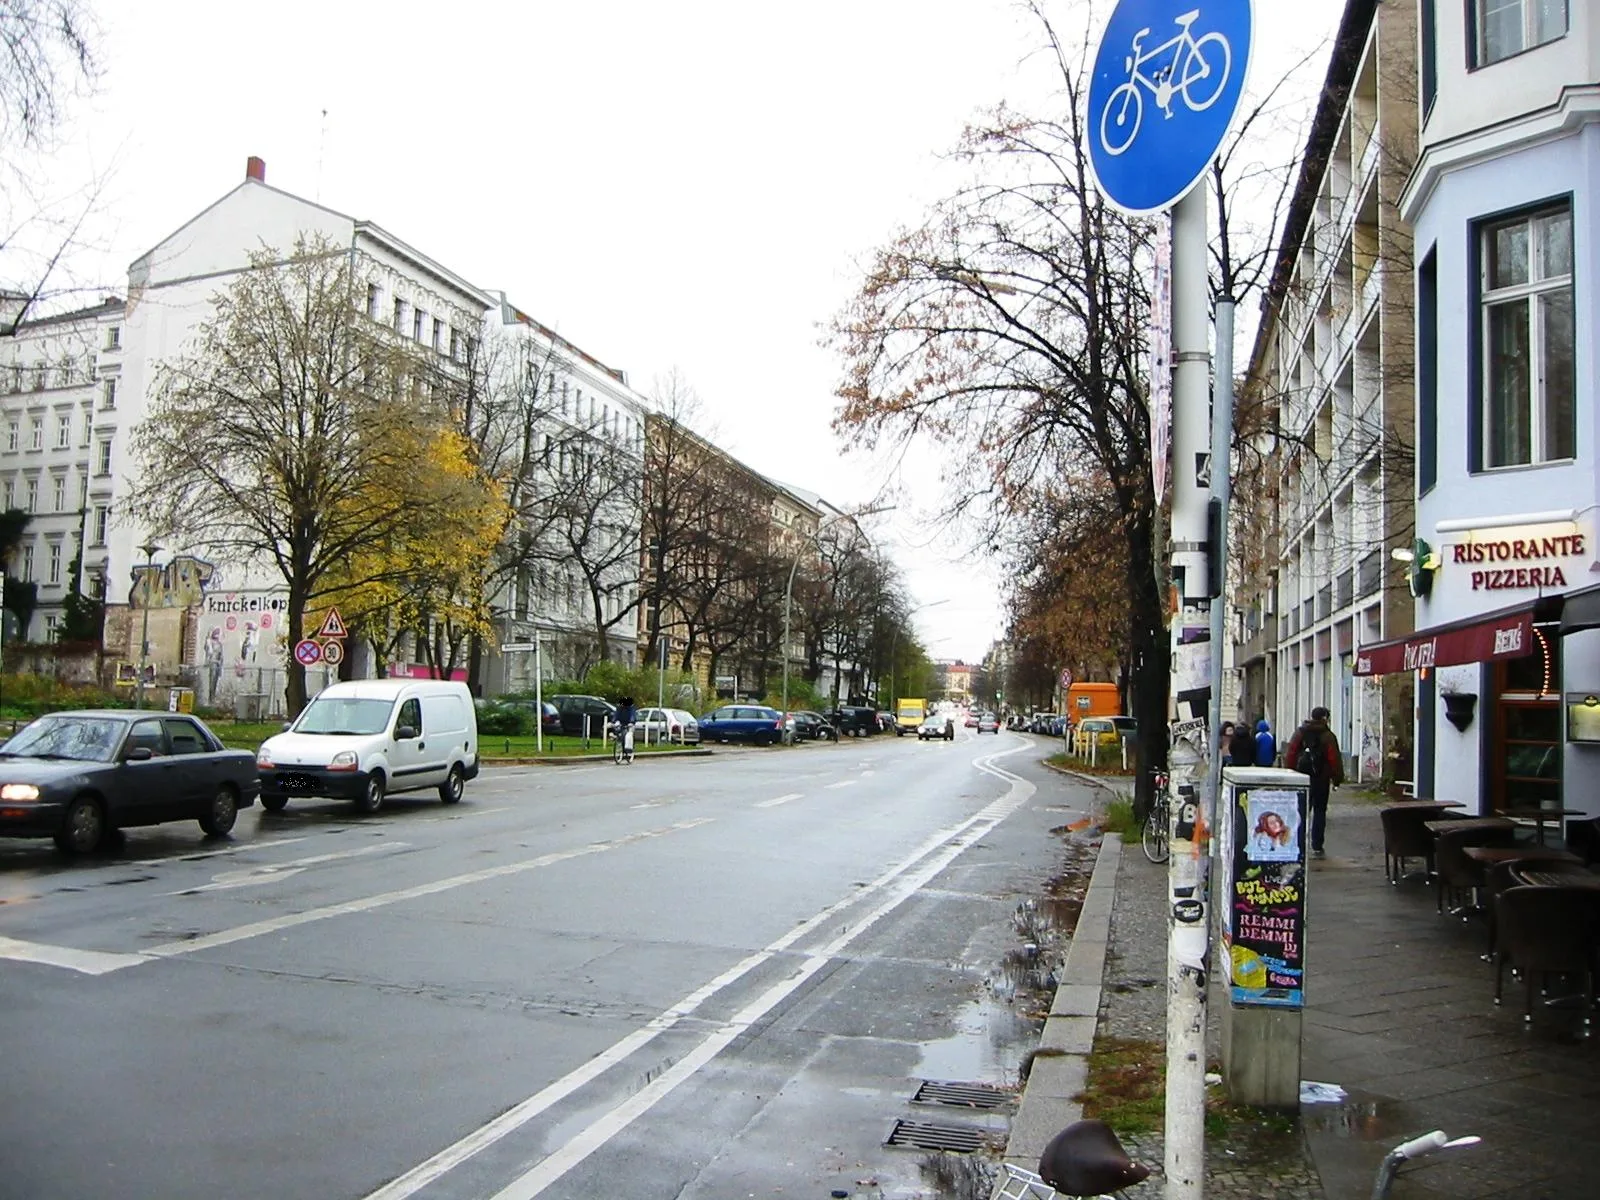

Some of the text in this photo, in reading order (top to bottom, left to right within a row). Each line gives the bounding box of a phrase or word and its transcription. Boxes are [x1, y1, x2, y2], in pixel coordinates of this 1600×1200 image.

[1453, 534, 1585, 563] RISTORANTE
[1471, 566, 1567, 590] PIZZERIA
[327, 647, 336, 658] 30
[1240, 914, 1296, 930] REMMI
[1239, 927, 1295, 943] DEMMI
